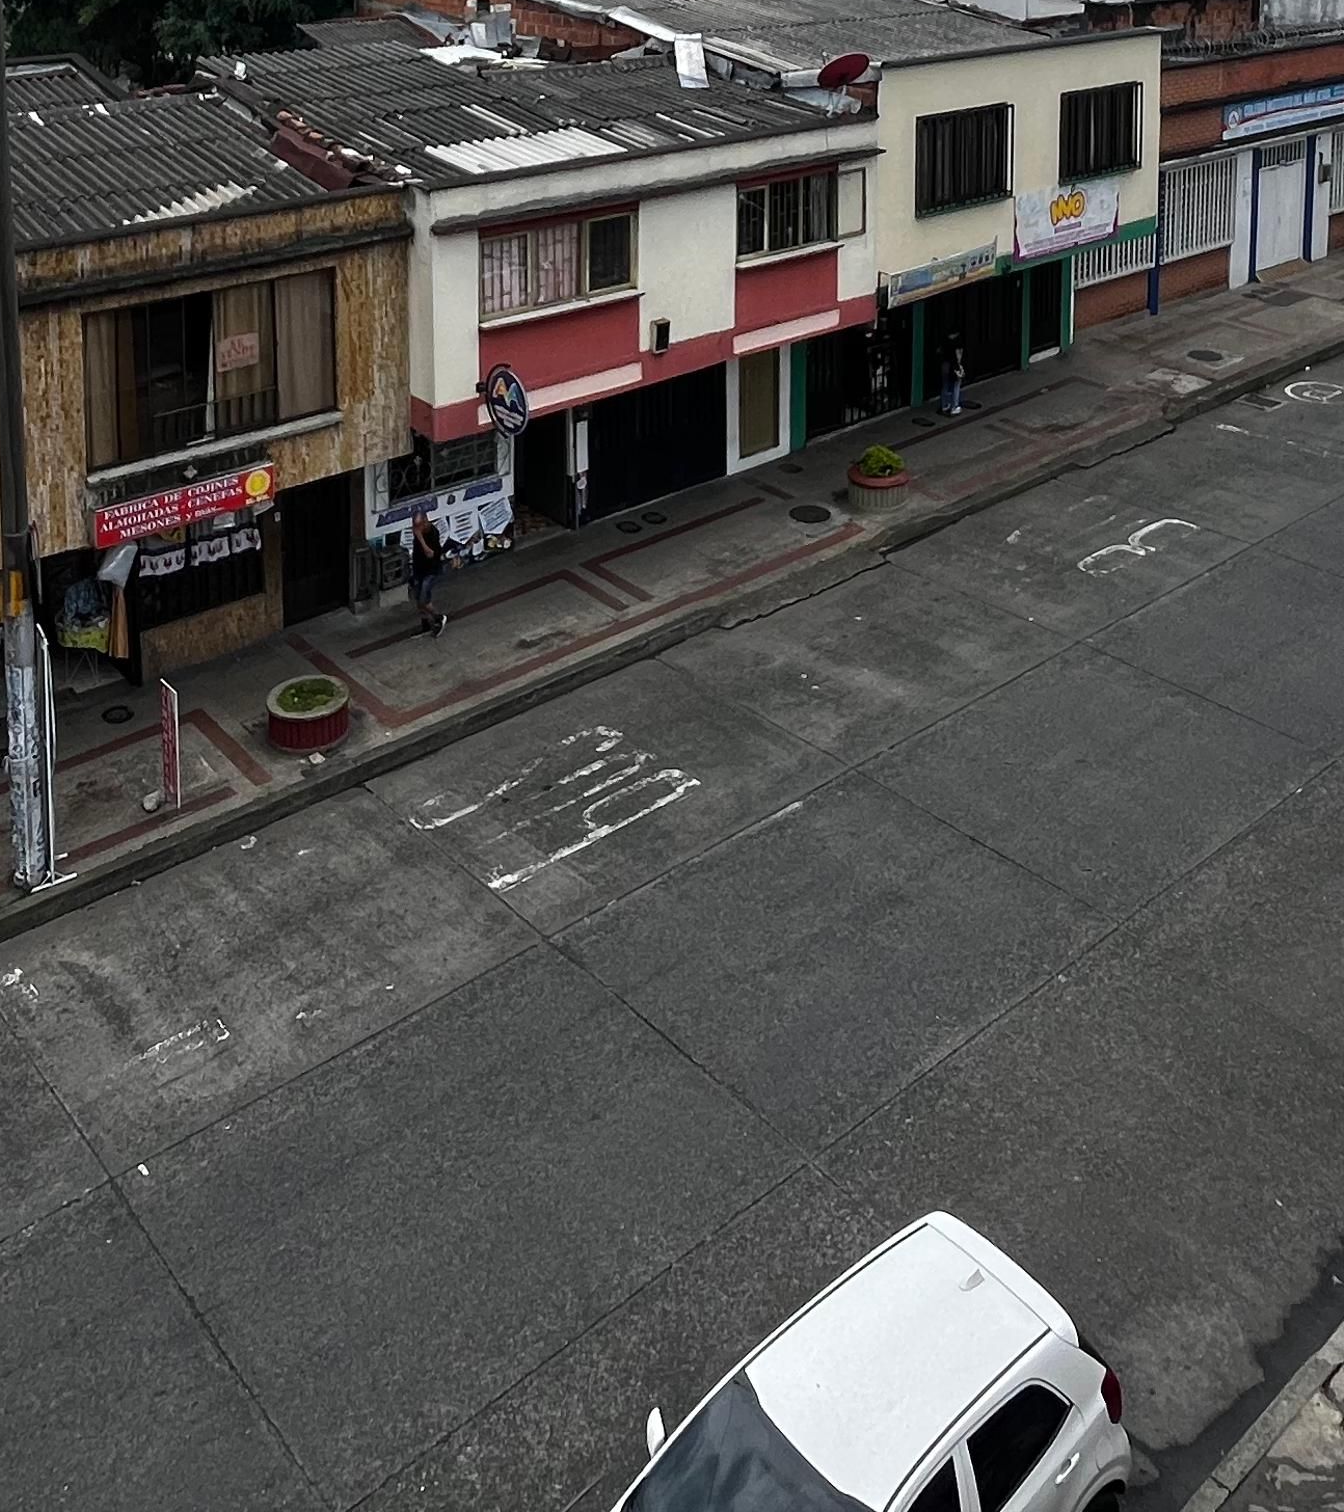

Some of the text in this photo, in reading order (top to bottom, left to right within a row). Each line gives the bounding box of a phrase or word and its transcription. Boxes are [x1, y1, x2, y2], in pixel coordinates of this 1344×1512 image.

[100, 505, 179, 532] ALMOHADAS
[187, 487, 243, 509] CENEFAS
[104, 476, 239, 520] FABRICA DE COJINES
[120, 515, 181, 539] MESONES
